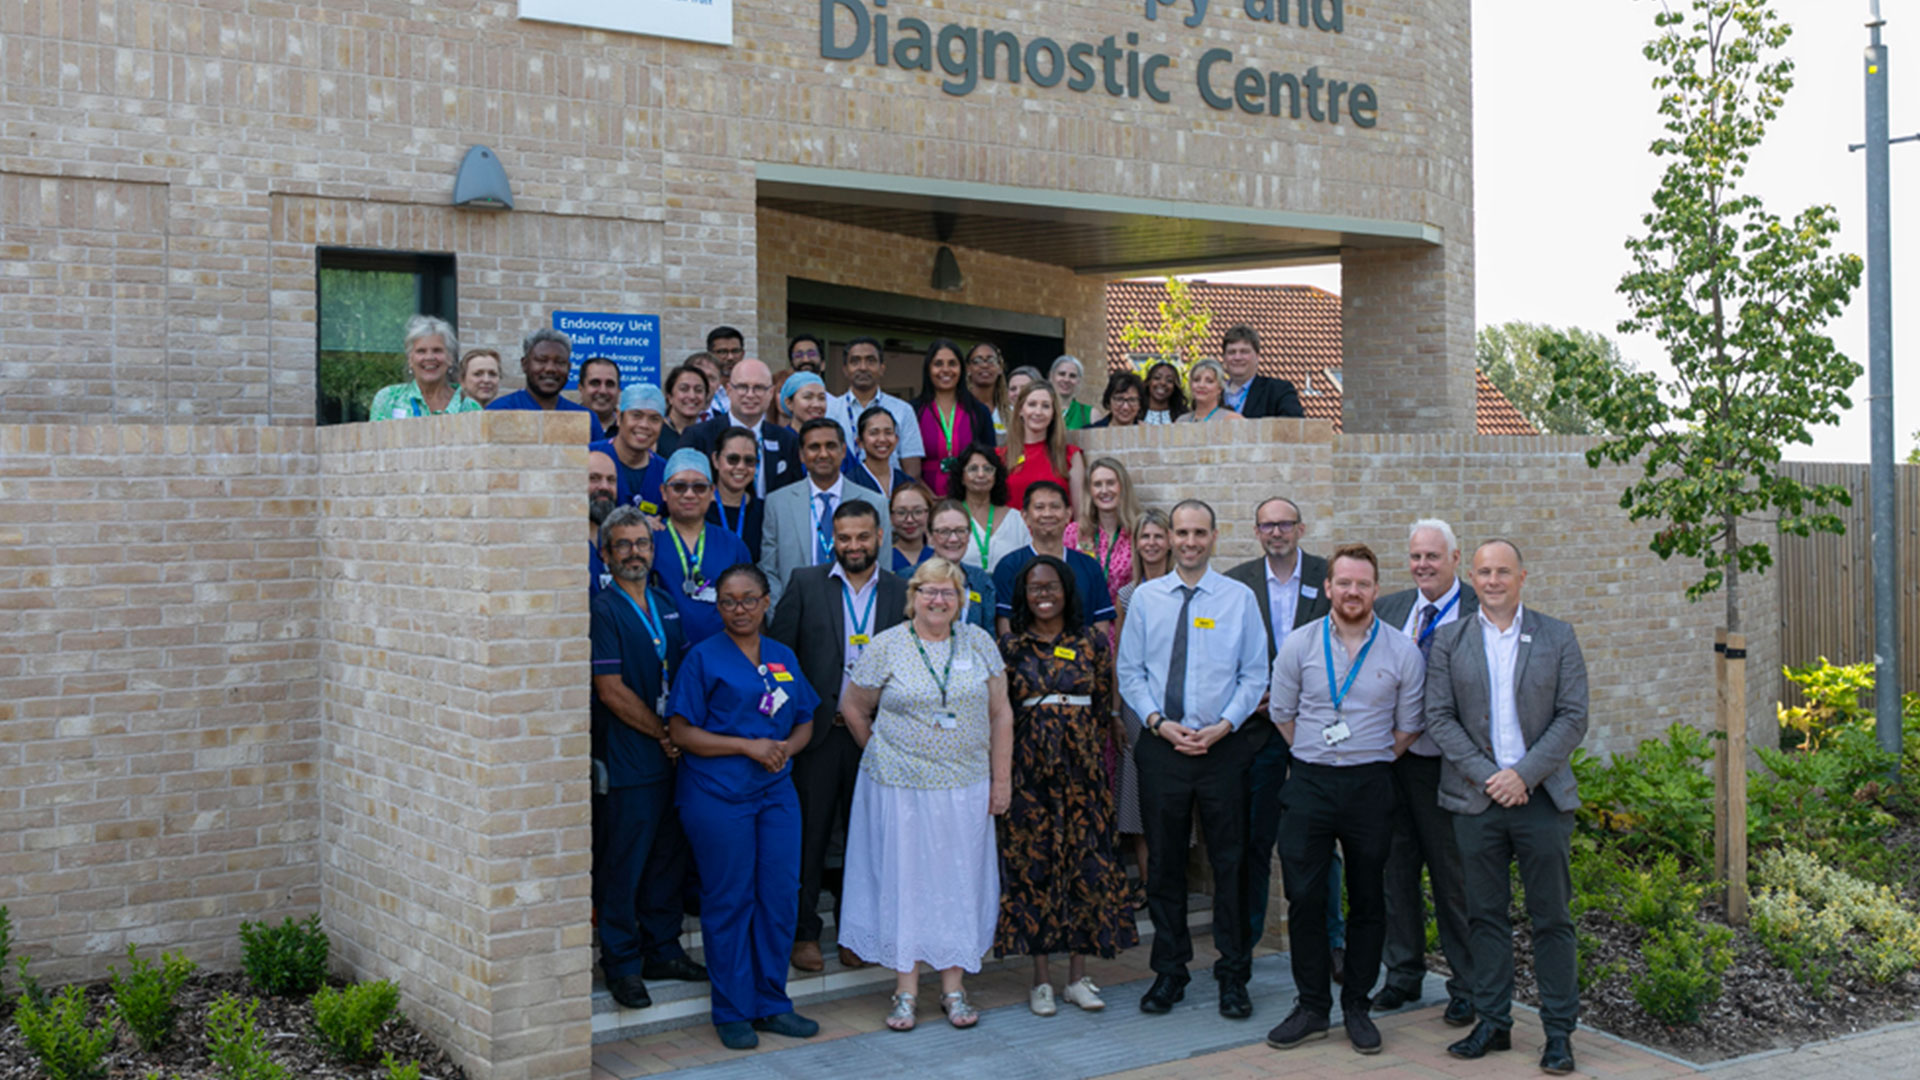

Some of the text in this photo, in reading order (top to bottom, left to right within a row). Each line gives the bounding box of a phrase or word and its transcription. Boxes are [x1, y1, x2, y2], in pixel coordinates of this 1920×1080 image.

[820, 0, 1378, 129] Diagnostic Centre
[560, 317, 654, 333] Endoscopy Unit
[599, 333, 650, 347] Entrance
